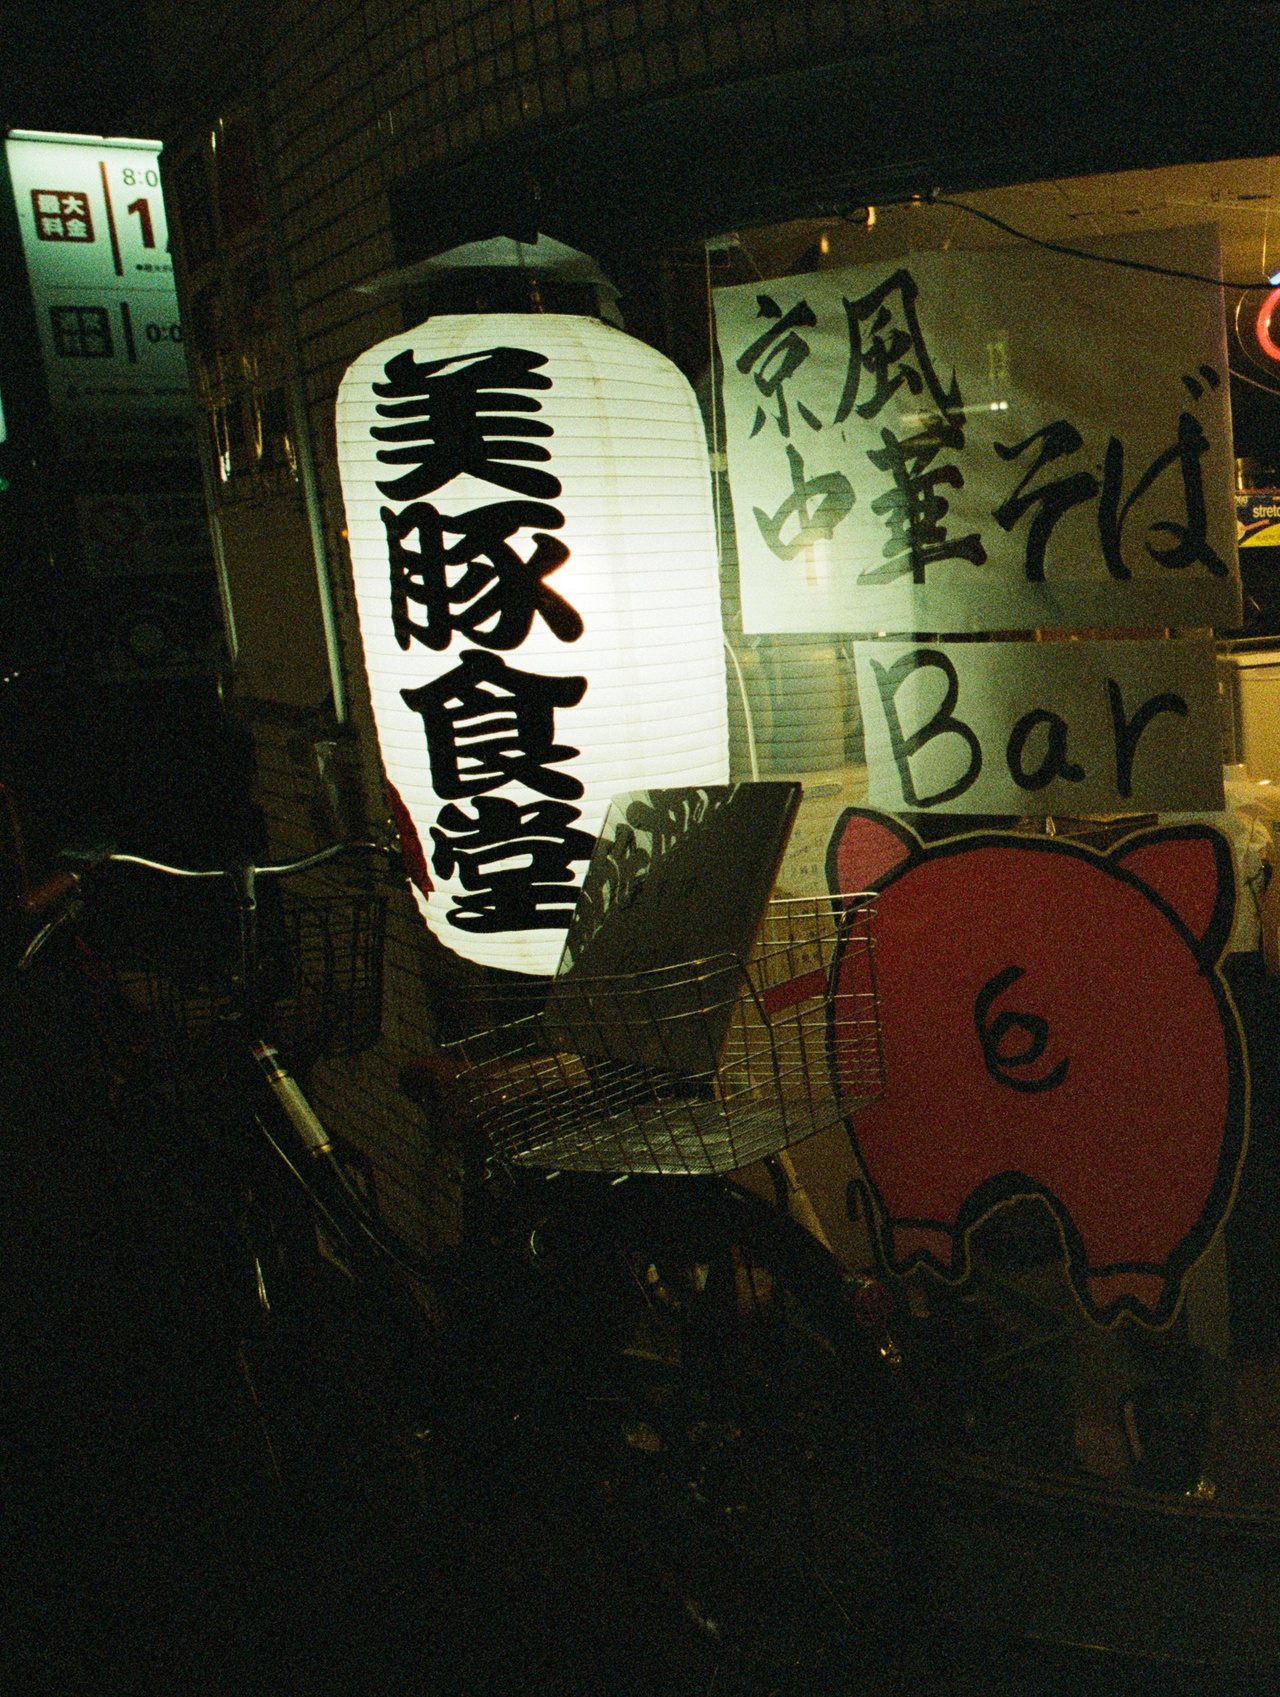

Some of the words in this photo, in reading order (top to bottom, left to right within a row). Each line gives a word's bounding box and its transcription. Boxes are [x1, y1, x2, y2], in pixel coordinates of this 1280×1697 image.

[735, 267, 968, 439] 京風
[752, 364, 1230, 584] 中華そば
[369, 346, 597, 933] 美豚食堂
[870, 648, 1189, 809] Bar
